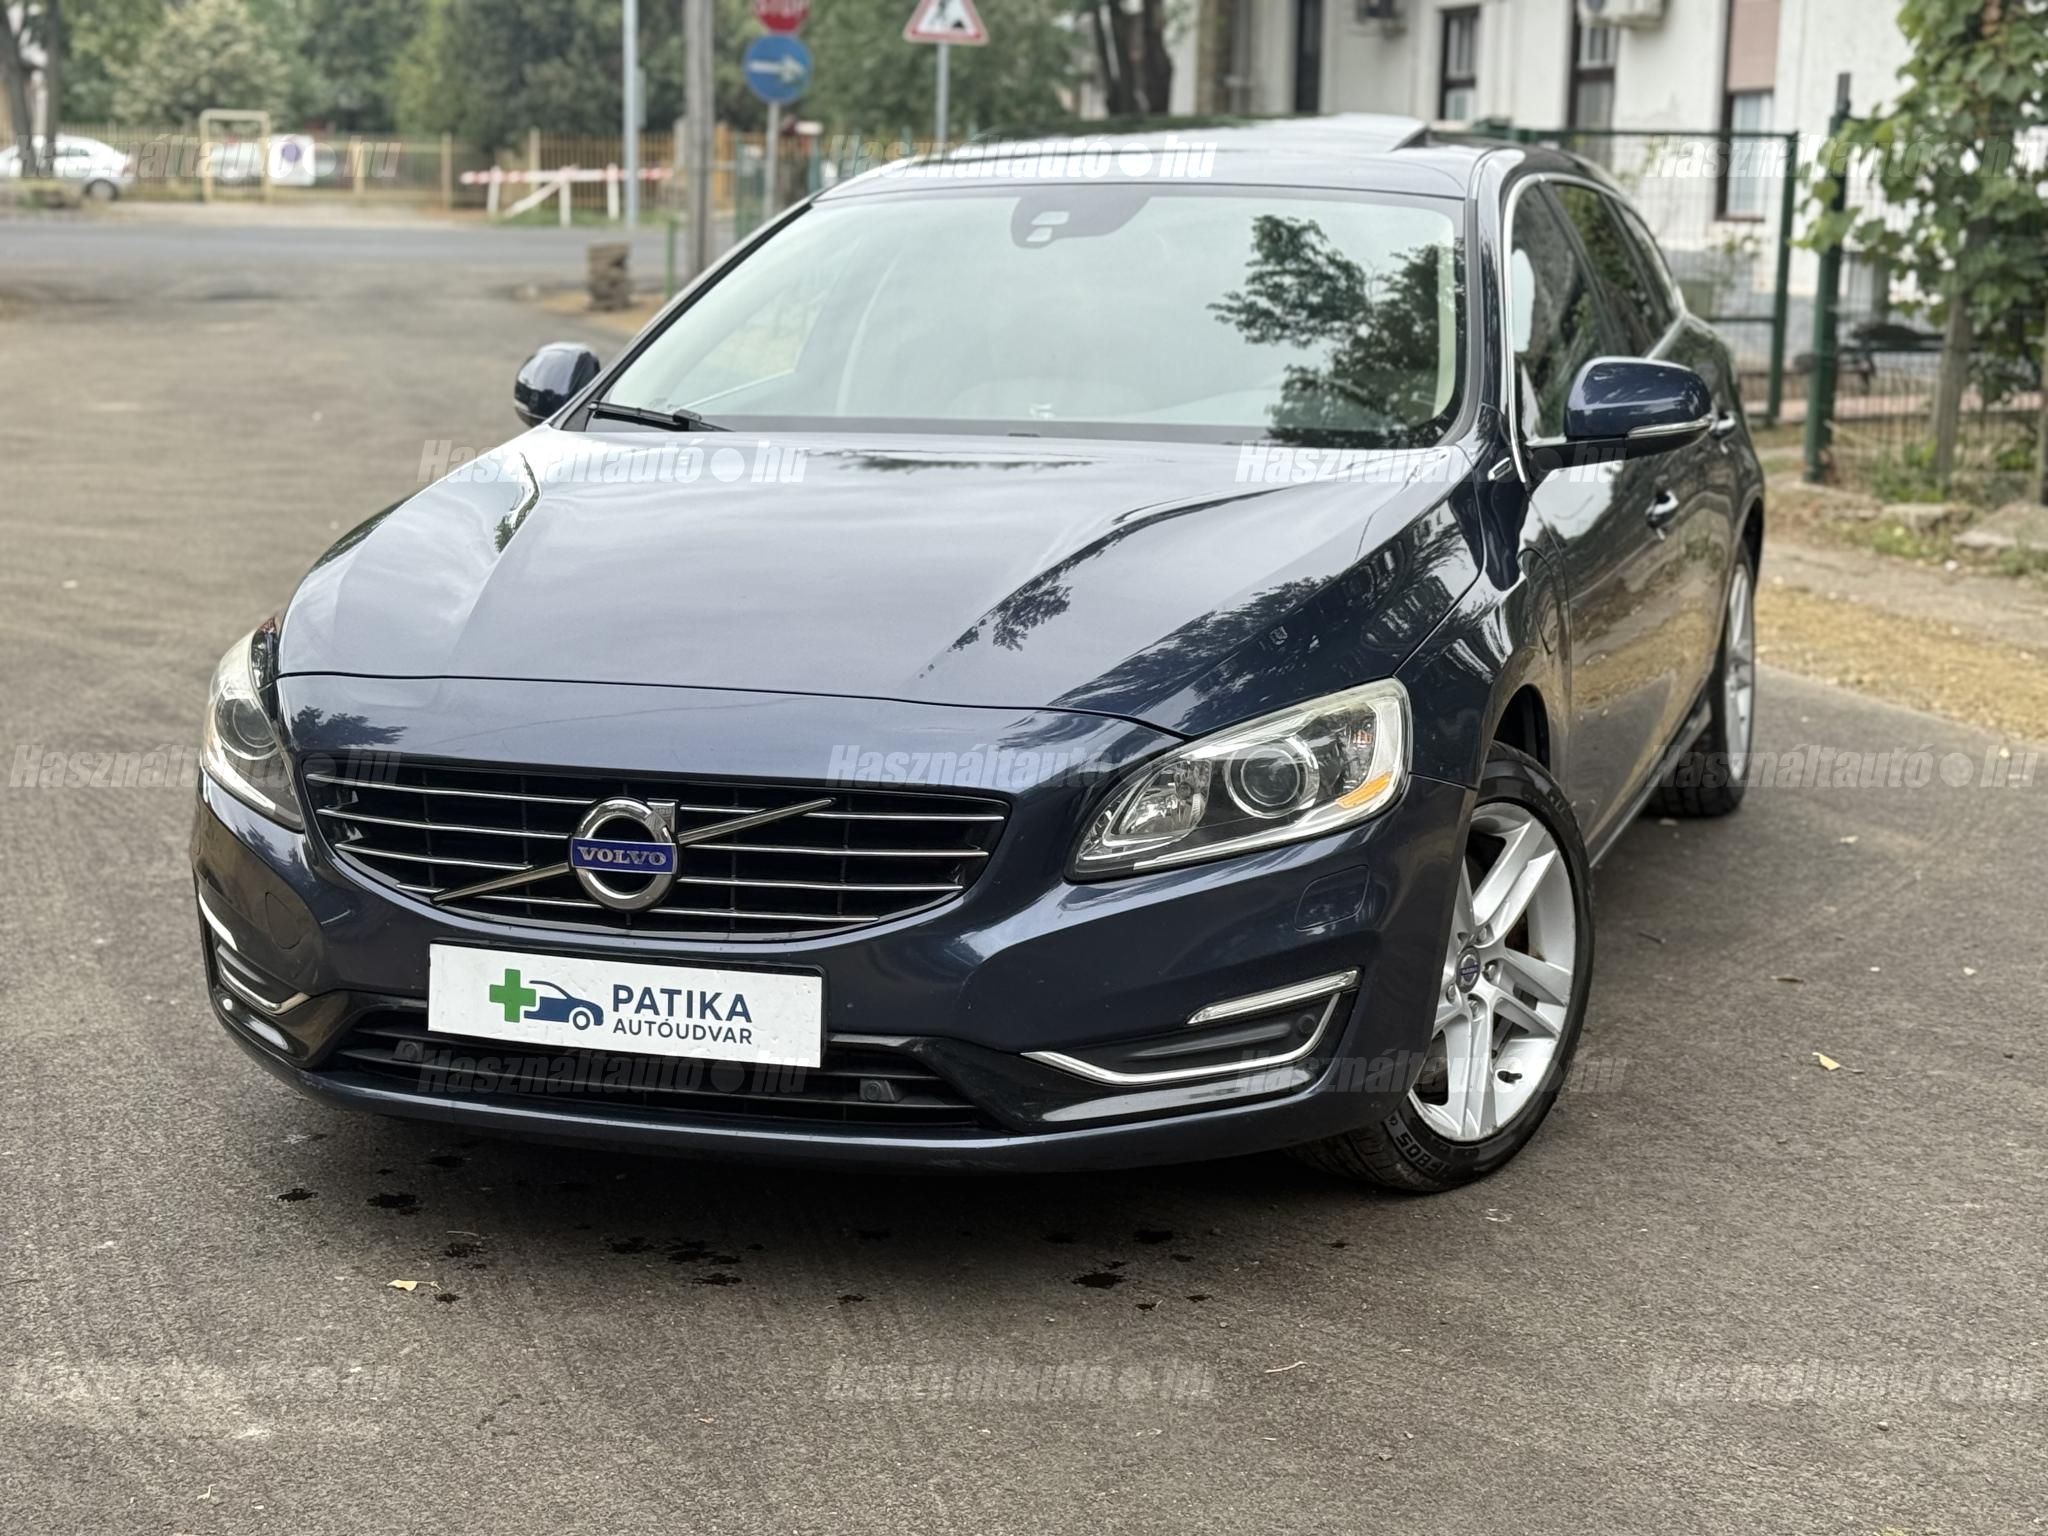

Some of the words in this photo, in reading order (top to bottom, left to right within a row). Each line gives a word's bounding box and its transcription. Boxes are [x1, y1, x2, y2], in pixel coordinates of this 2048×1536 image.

[577, 846, 667, 866] VOLVO
[611, 984, 754, 1024] PATIKA
[611, 1017, 754, 1045] AUTÓUDVAR
